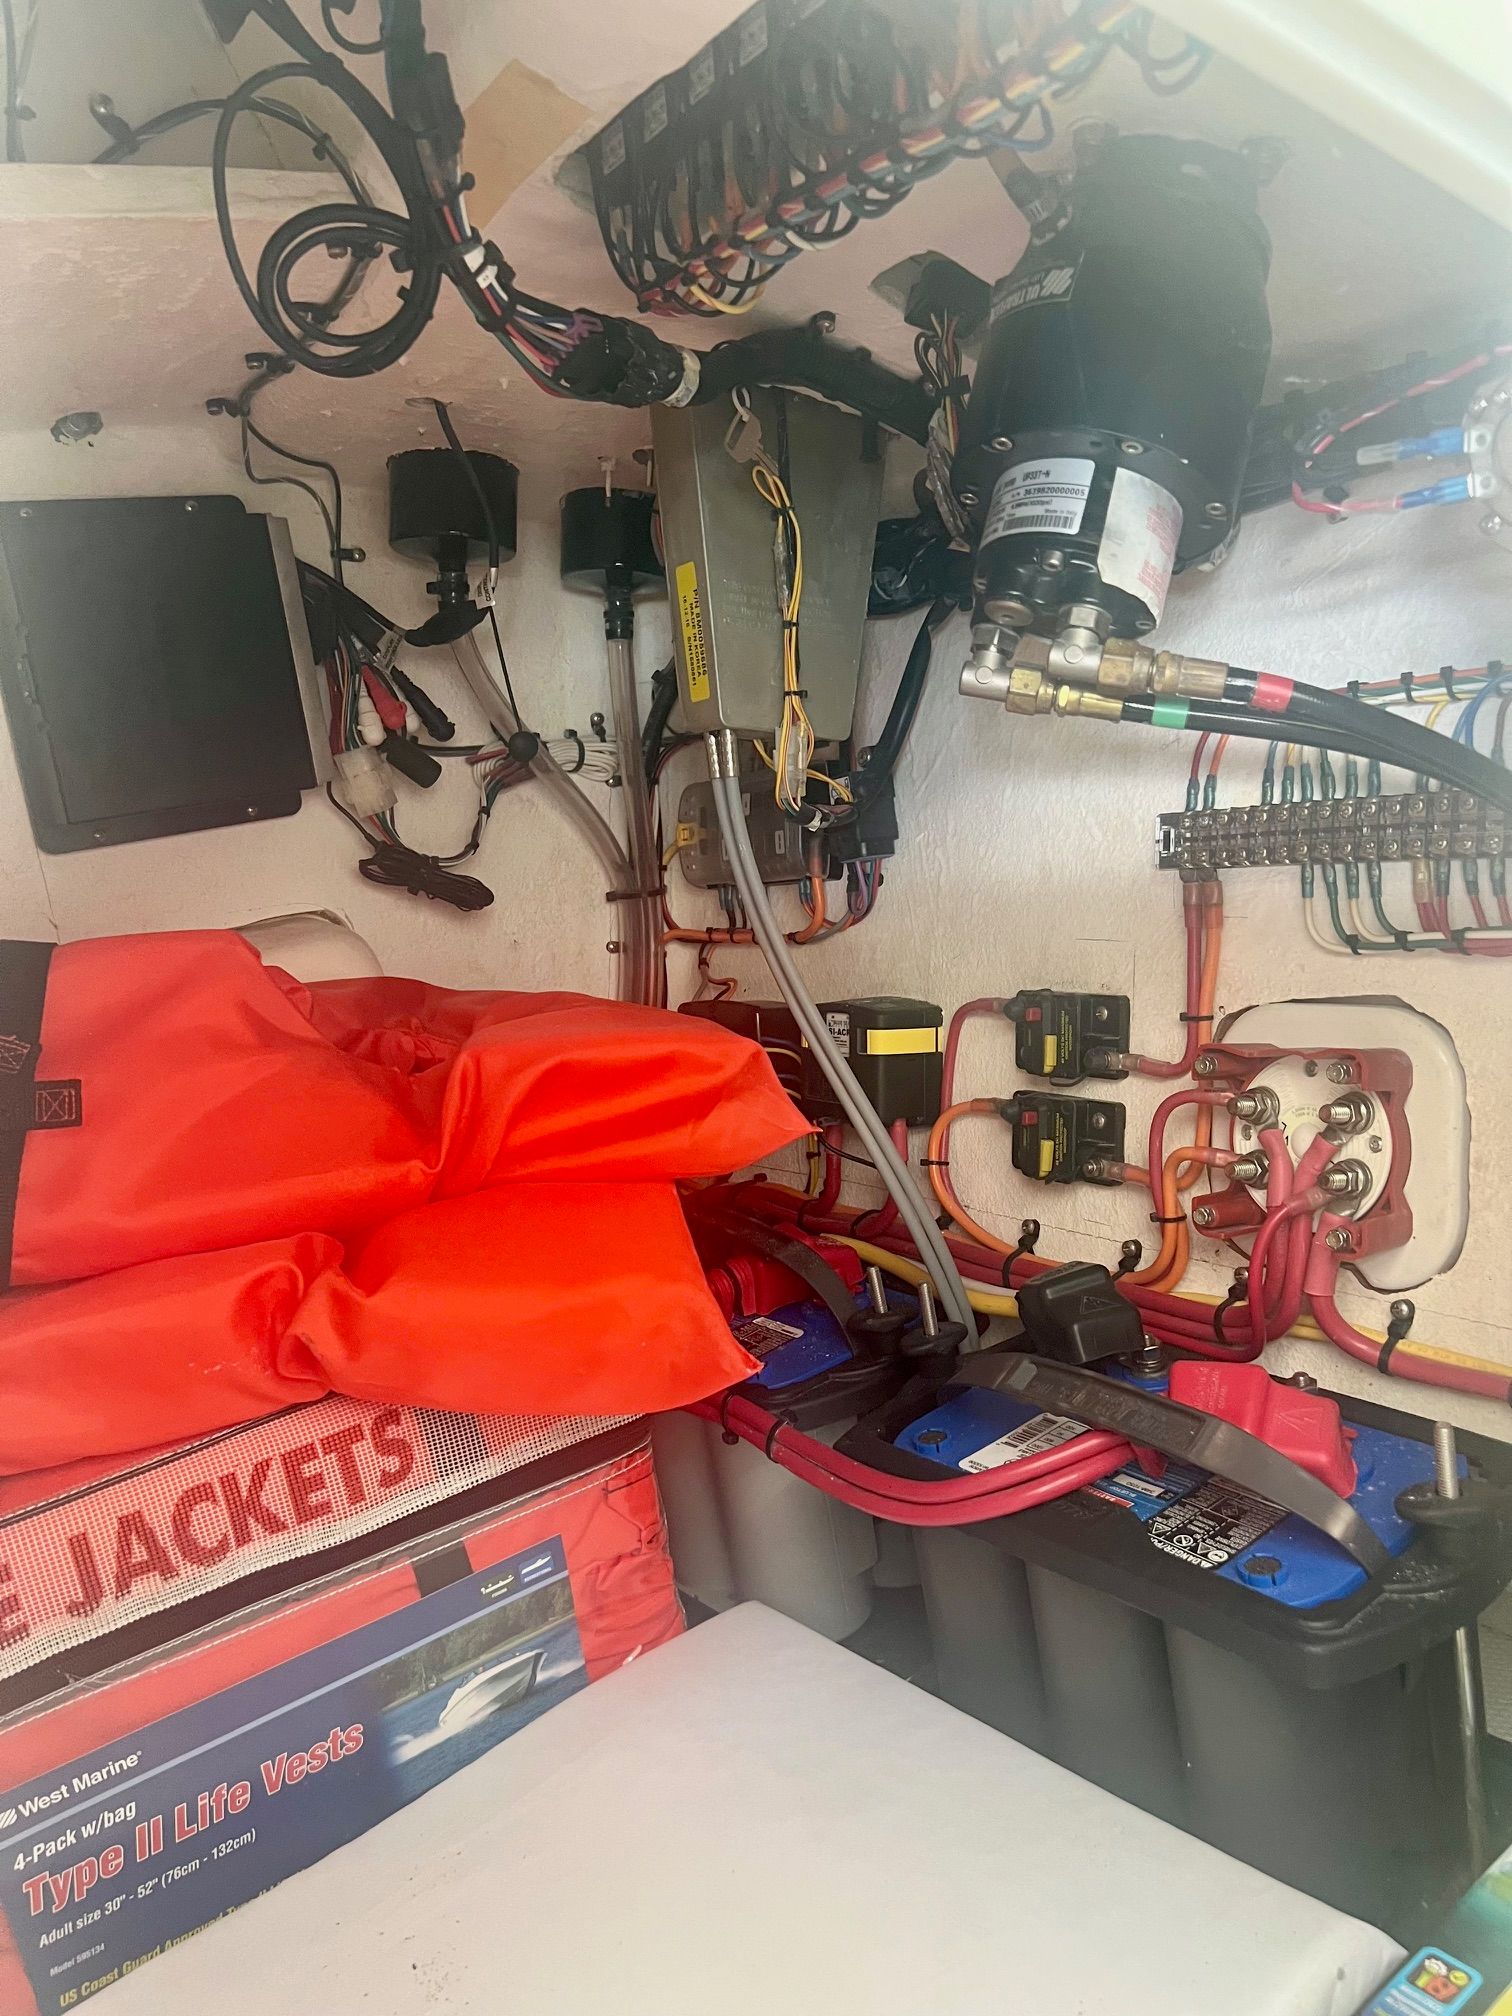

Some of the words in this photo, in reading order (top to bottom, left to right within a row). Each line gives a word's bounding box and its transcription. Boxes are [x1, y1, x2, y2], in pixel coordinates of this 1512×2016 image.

[694, 645, 702, 677] KOREA
[64, 1408, 415, 1618] JACKETS
[19, 1784, 70, 1818] West
[23, 1845, 124, 1916] Type
[136, 1815, 163, 1862] II
[175, 1782, 250, 1843] Life
[260, 1723, 364, 1795] Vests
[13, 1829, 77, 1871] 4-Pack
[81, 1801, 137, 1839] w/bag
[39, 1918, 73, 1948] Adult
[76, 1909, 101, 1930] size
[105, 1894, 127, 1916] 30"
[137, 1878, 159, 1899] 52"
[161, 1859, 200, 1888] (76cm
[211, 1828, 257, 1860] 132cm)
[50, 1958, 75, 1977] Model
[60, 1990, 78, 2007] US
[81, 1969, 119, 1997] Coast
[122, 1945, 161, 1976] Guard
